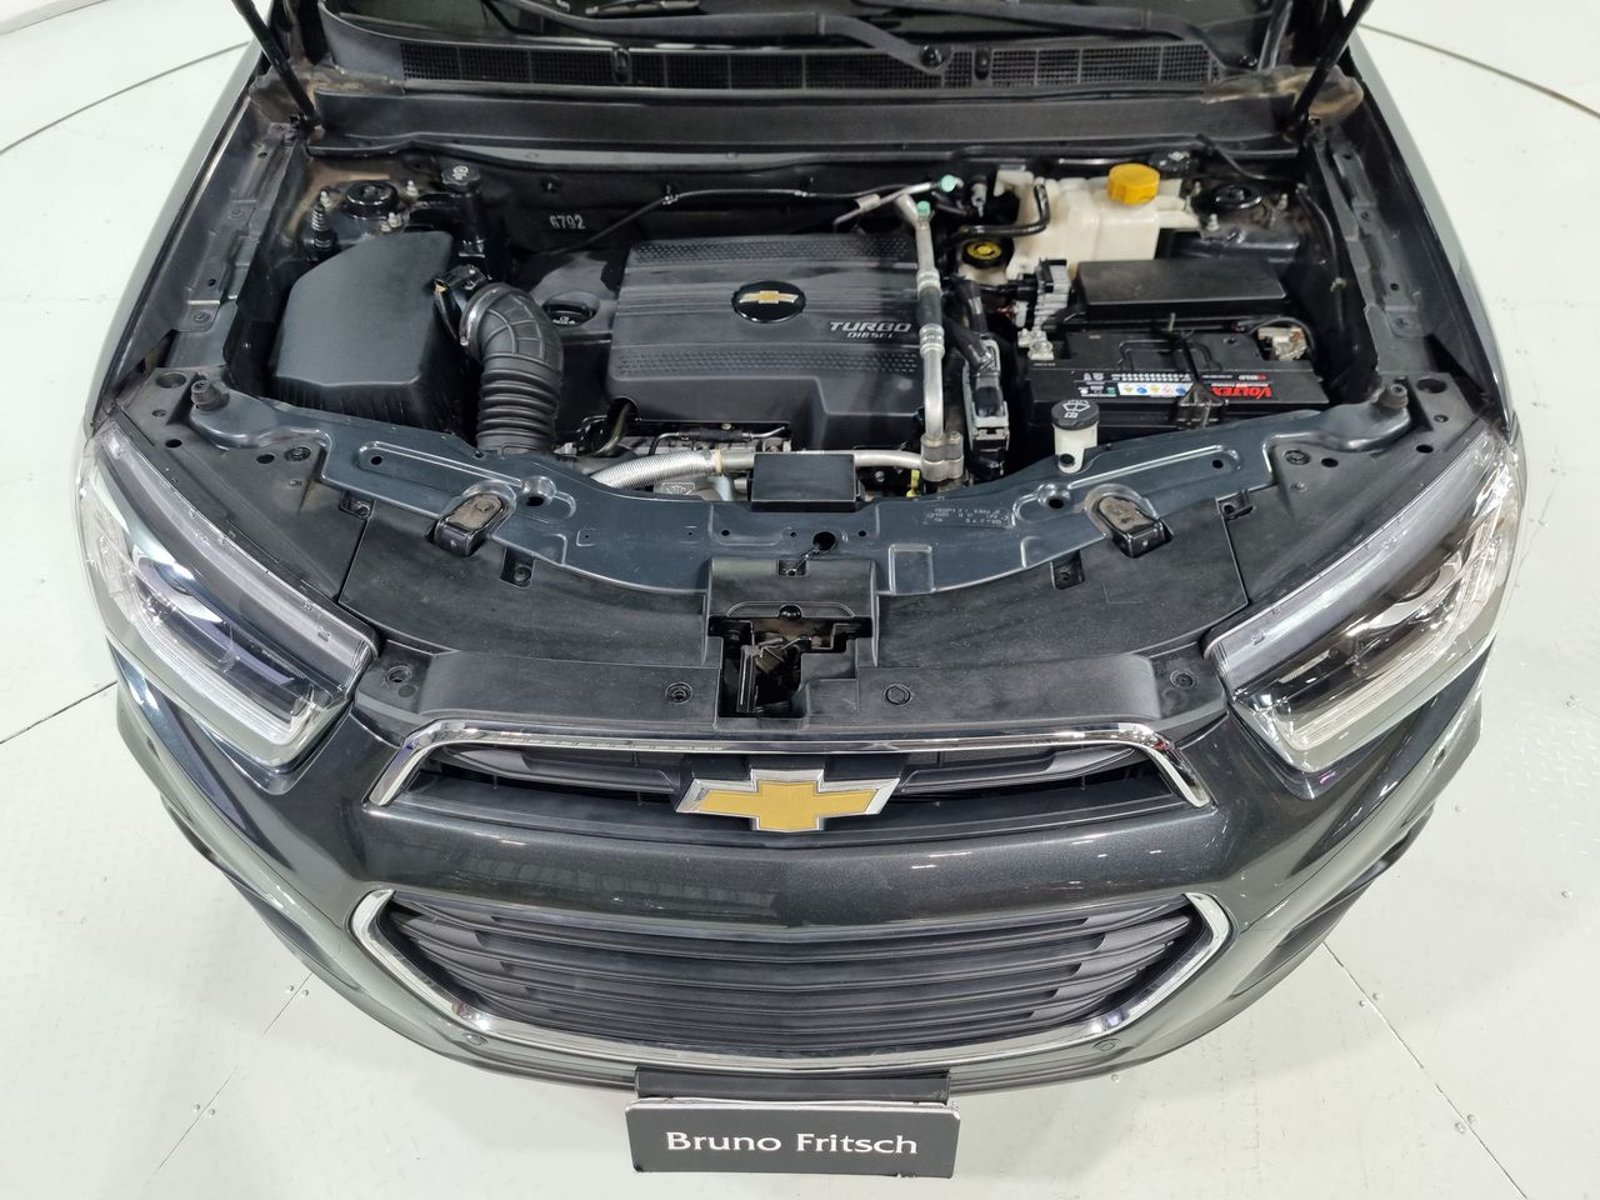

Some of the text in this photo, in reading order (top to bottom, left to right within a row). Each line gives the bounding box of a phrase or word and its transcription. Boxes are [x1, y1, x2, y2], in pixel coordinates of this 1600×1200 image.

[829, 321, 912, 332] TURBO
[665, 1131, 918, 1155] Bruno Fritsch
